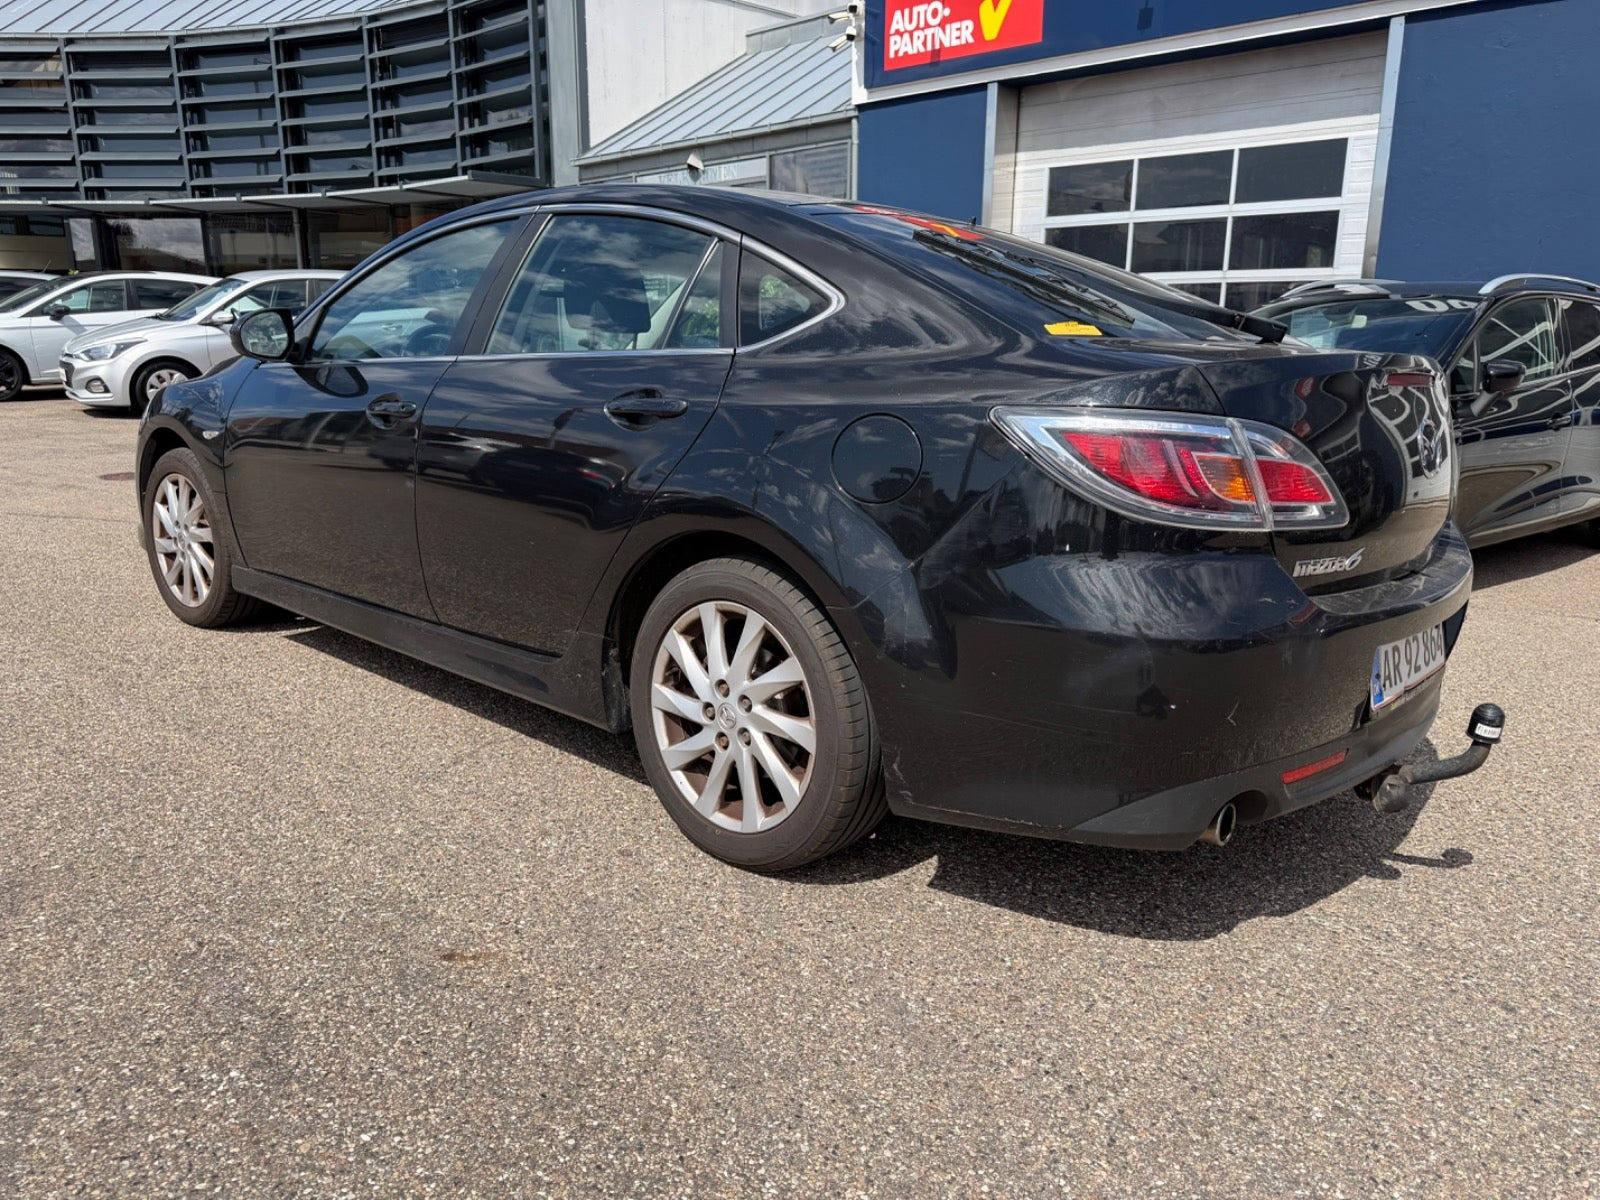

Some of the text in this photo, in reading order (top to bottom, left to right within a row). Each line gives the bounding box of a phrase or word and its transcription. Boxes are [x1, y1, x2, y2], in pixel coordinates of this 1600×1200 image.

[889, 19, 975, 58] PARTNER
[1383, 626, 1443, 690] AR 92 864
